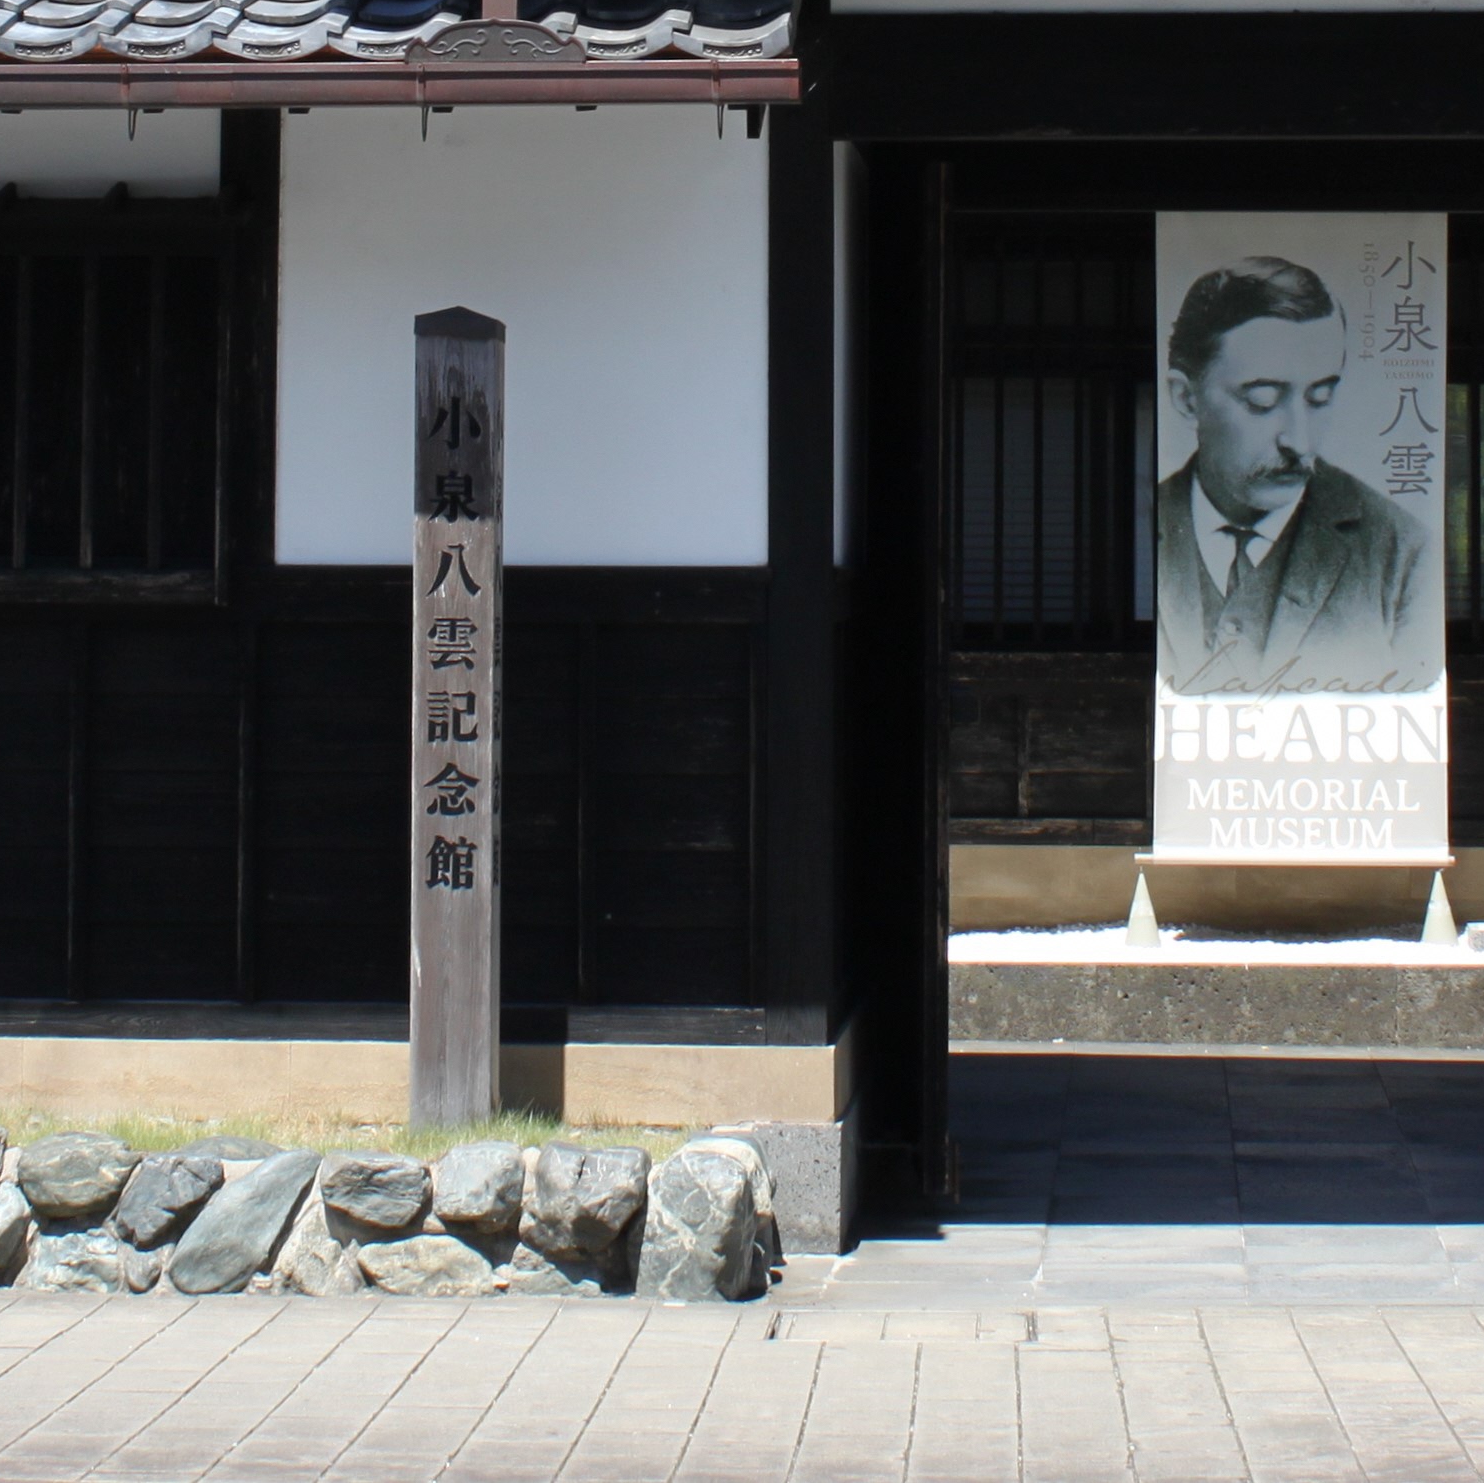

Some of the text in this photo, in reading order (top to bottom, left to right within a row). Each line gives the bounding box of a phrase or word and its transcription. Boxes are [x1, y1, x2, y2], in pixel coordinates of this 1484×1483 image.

[1379, 240, 1439, 496] 小泉八雲
[424, 395, 482, 890] 小泉八雲記念館
[1156, 703, 1448, 763] HEARN
[1186, 778, 1421, 812] MEMORIAL
[1208, 818, 1396, 850] MUSEUM
